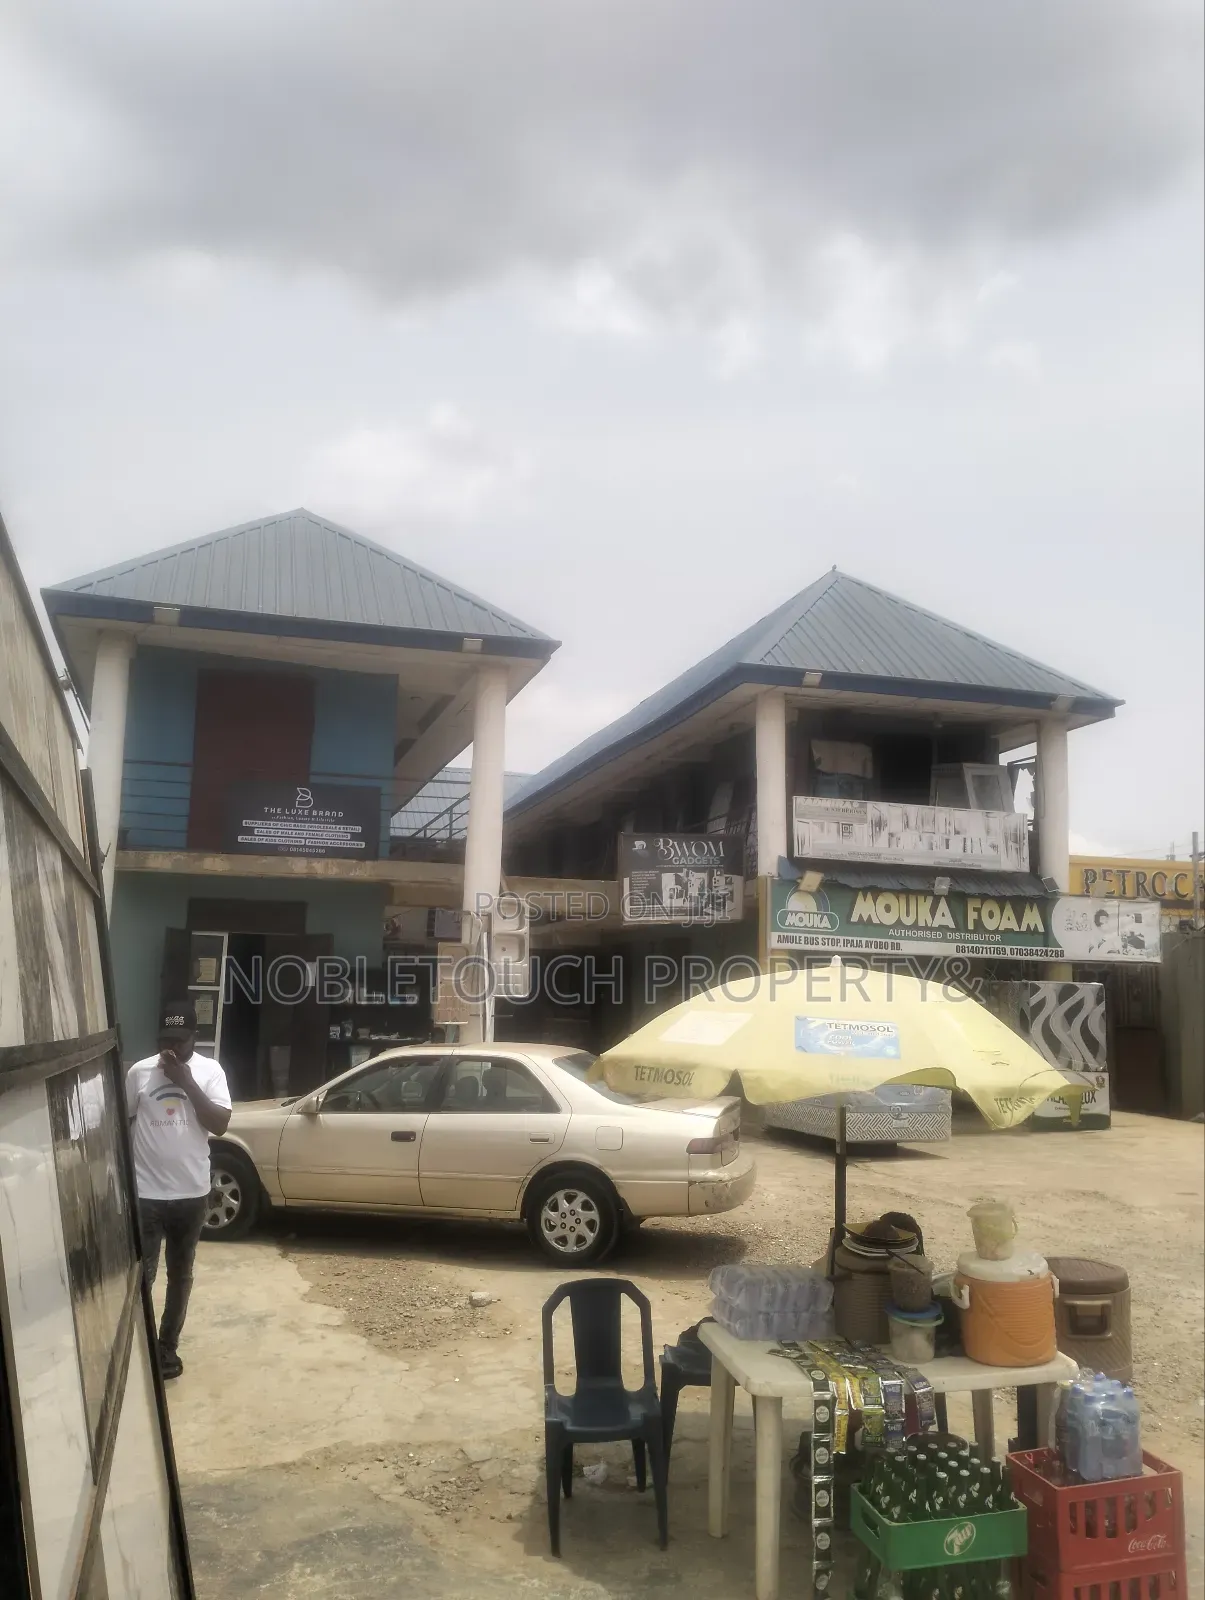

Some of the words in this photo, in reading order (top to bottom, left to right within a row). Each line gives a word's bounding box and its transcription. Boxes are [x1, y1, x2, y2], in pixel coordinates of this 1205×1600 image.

[285, 808, 309, 816] LUXE
[312, 810, 344, 818] BRAND
[653, 838, 725, 860] BWOM
[672, 856, 721, 865] GADGETS
[784, 911, 832, 929] MOUKA
[850, 890, 956, 929] MOUKA
[967, 898, 1045, 933] FOAM
[777, 934, 802, 945] AMULE
[804, 936, 820, 946] BUS
[843, 939, 863, 949] IPAJA
[864, 940, 889, 951] AYOBO
[888, 929, 943, 939] AUTHORISED
[947, 932, 1001, 942] DISTRIBUTOR
[826, 1022, 894, 1033] TETMOSOL
[633, 1065, 695, 1087] TETMOSOL
